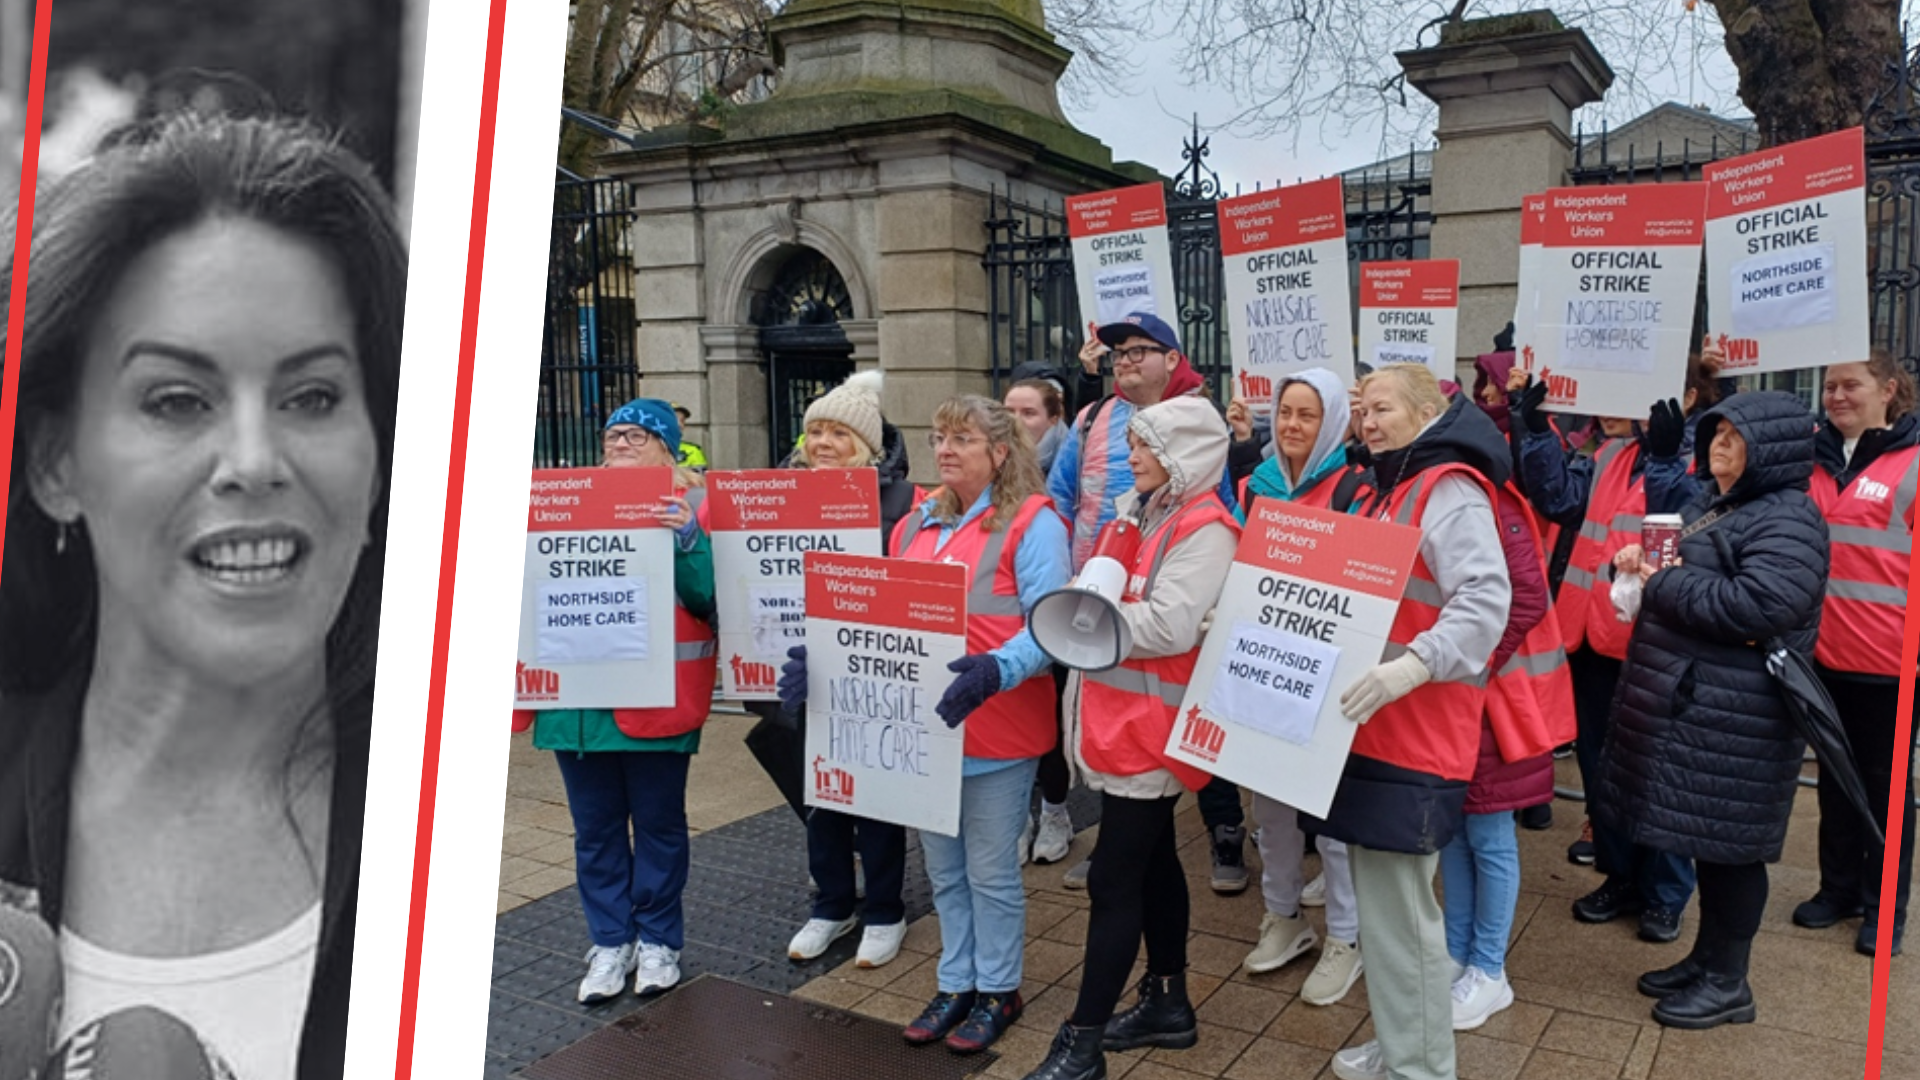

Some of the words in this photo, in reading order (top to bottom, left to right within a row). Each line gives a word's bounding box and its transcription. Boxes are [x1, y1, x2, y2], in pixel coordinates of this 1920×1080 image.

[1712, 154, 1785, 182] Independent
[1724, 174, 1773, 193] Workers
[1553, 194, 1627, 209] Independent
[1732, 190, 1766, 206] Union
[1224, 197, 1281, 218] Independent
[1564, 210, 1614, 222] Workers
[1234, 215, 1274, 230] Workers
[1736, 202, 1828, 235] OFFICIAL
[1242, 231, 1268, 244] Union
[1570, 225, 1605, 238] Union
[1747, 225, 1819, 255] STRIKE
[1091, 232, 1147, 251] OFFICIAL
[1099, 248, 1143, 266] STRIKE
[1247, 248, 1318, 273] OFFICIAL
[1571, 251, 1662, 269] OFFICIAL
[1365, 267, 1411, 279] Independent
[1741, 257, 1823, 285] NORTHSIDE
[1256, 271, 1312, 294] STRIKE
[1579, 275, 1652, 293] STRIKE
[1741, 284, 1783, 303] HOME
[1786, 276, 1825, 295] CARE
[1100, 289, 1125, 300] HOME
[1126, 285, 1150, 297] CARE
[1378, 311, 1434, 325] OFFICIAL
[1293, 323, 1332, 361] CARE
[1384, 328, 1428, 343] STRIKE
[531, 476, 592, 493] ependent
[716, 478, 797, 492] Independent
[530, 494, 580, 506] Workers
[731, 494, 786, 506] Workers
[534, 510, 571, 521] Union
[741, 510, 778, 521] Union
[1258, 506, 1336, 535] Independent
[538, 535, 636, 554] OFFICIAL
[746, 535, 845, 553] OFFICIAL
[1265, 527, 1317, 549] Workers
[1266, 545, 1302, 564] Union
[550, 559, 626, 578] STRIKE
[760, 558, 804, 576] STR
[813, 561, 888, 580] Independent
[825, 579, 877, 597] Workers
[1258, 576, 1353, 618] OFFICIAL
[548, 591, 635, 607] NORTHSIDE
[833, 597, 868, 613] Union
[548, 613, 591, 627] HOME
[596, 611, 636, 625] CARE
[1258, 604, 1338, 643] STRIKE
[837, 628, 930, 657] OFFICIAL
[1236, 637, 1322, 675] NORTHSIDE
[848, 654, 919, 682] STRIKE
[1228, 660, 1271, 686] HOME
[1272, 674, 1314, 699] CARE
[880, 725, 929, 776] CARE
